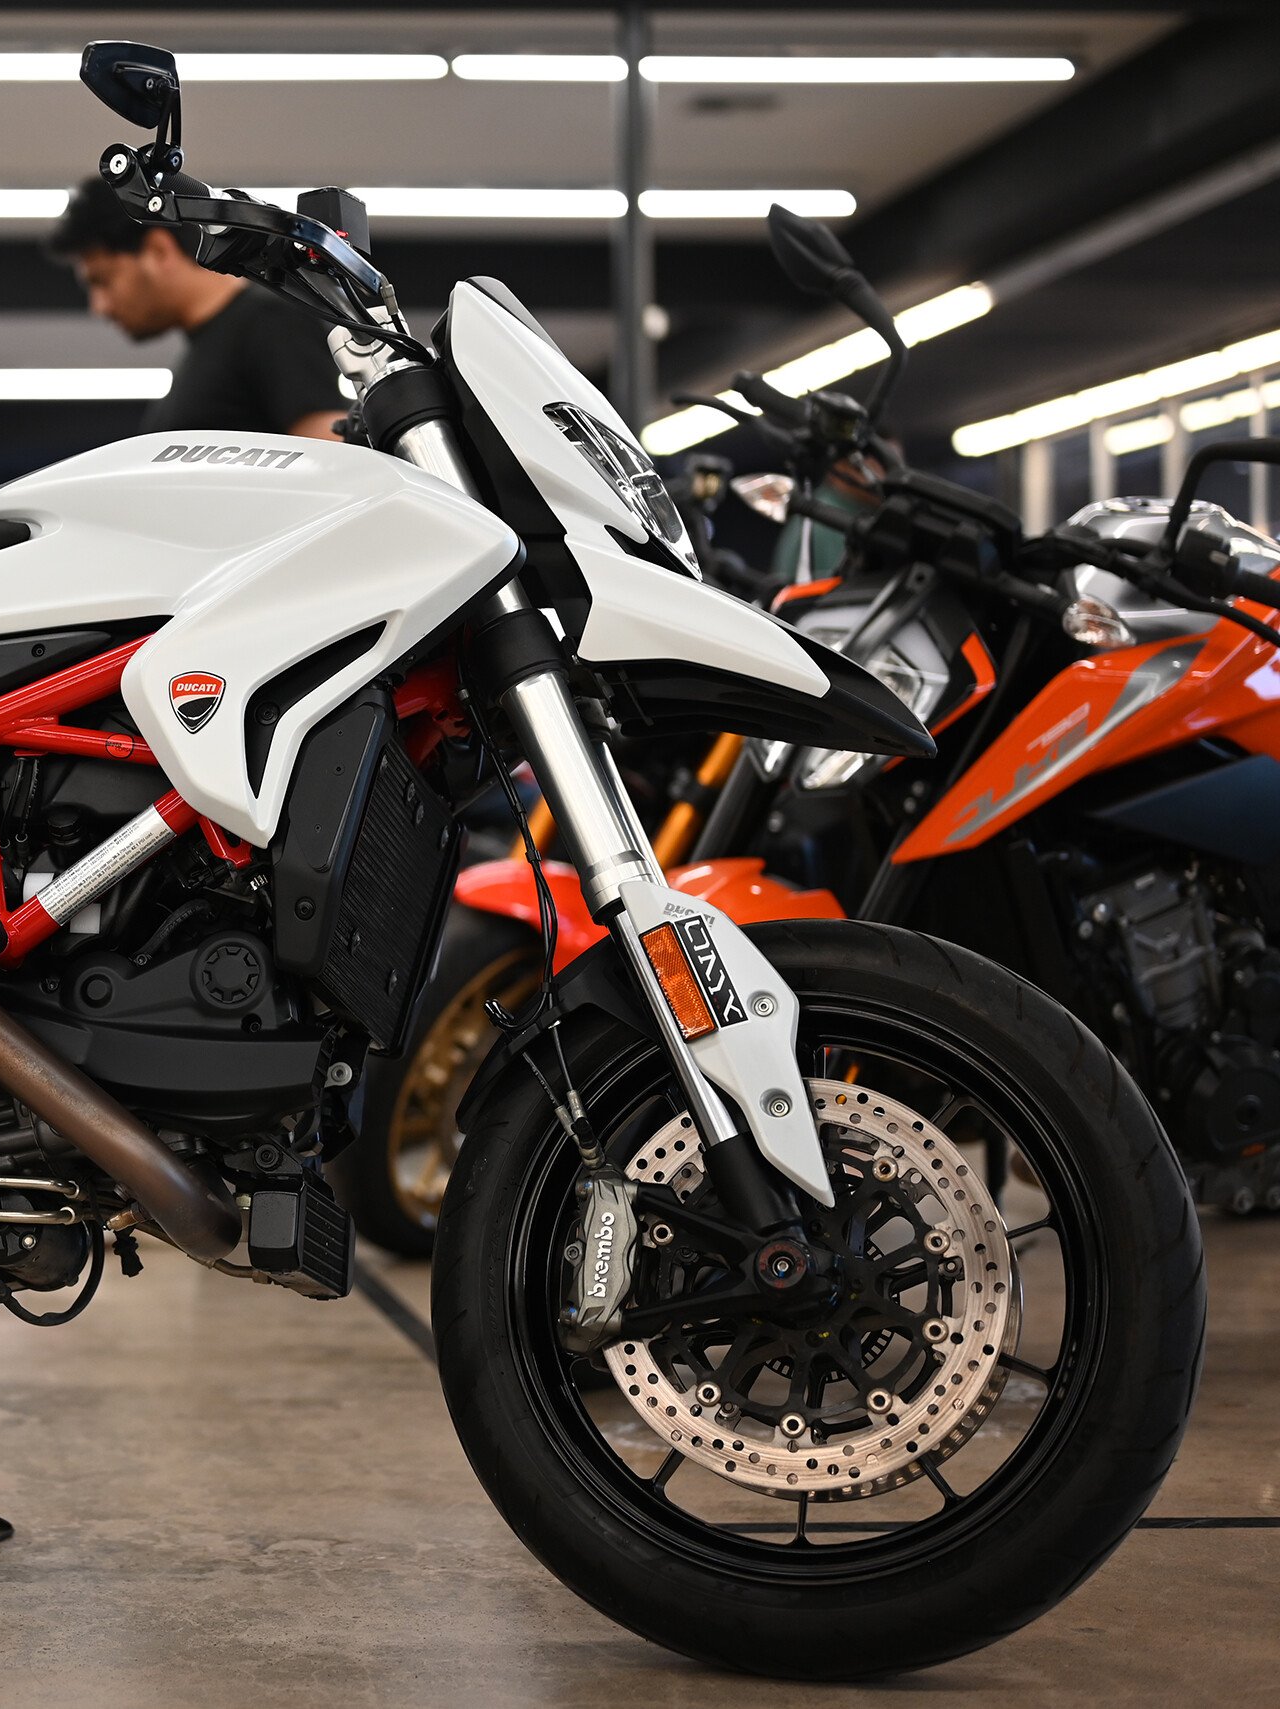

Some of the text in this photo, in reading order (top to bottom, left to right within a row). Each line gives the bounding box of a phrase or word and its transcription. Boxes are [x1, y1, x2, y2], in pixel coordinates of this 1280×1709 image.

[151, 445, 304, 469] DUCATI
[176, 683, 217, 692] DUCATI
[684, 920, 743, 1022] ONYX
[587, 1212, 615, 1298] brembo
